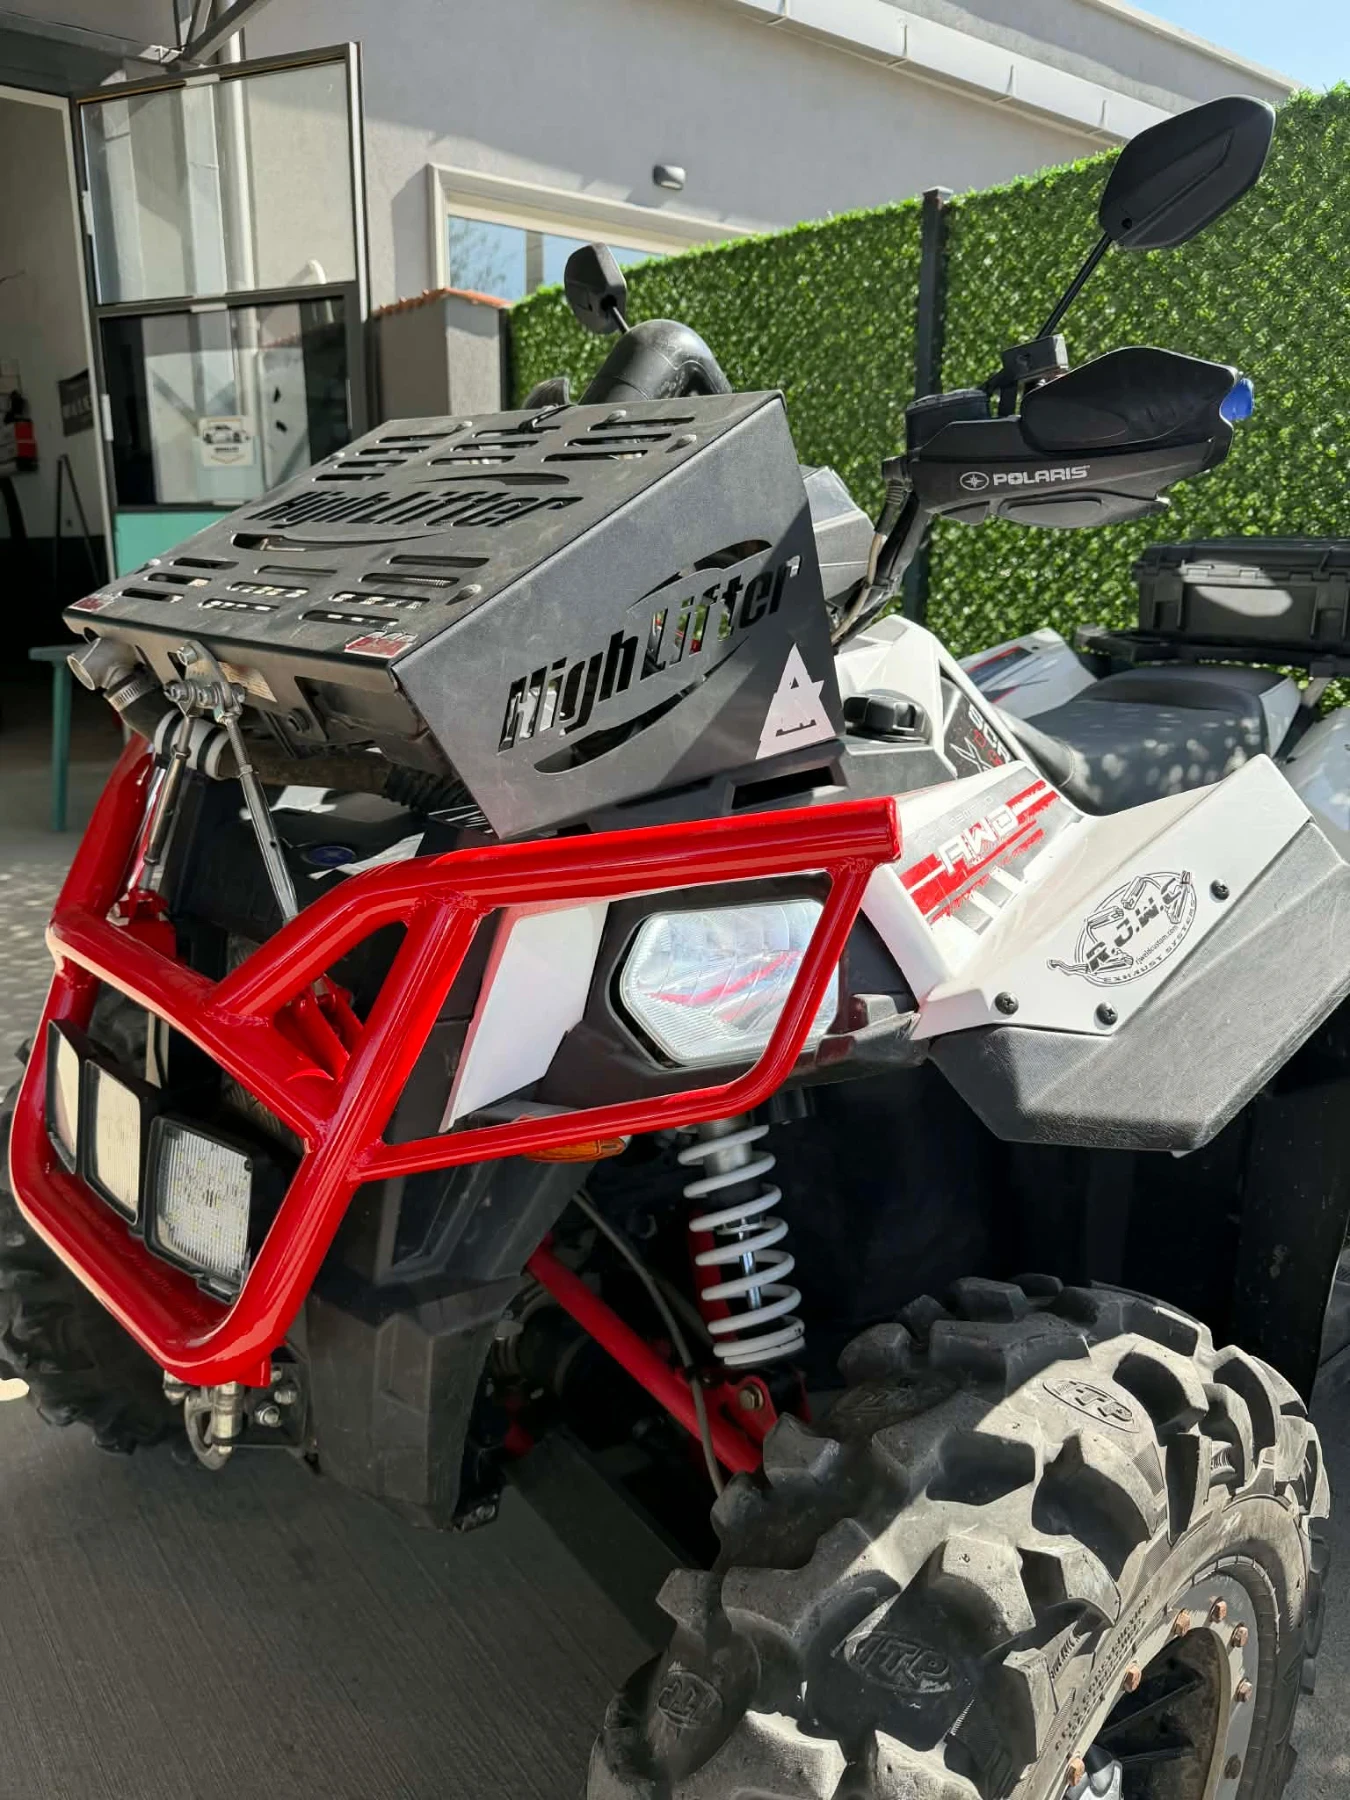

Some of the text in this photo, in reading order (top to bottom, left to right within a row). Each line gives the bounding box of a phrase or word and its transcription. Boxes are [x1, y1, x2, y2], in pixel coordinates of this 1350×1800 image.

[993, 466, 1089, 486] POLARIS
[938, 803, 1019, 874] AWD
[1103, 898, 1196, 983] EXHAUST SYSTEMS
[1054, 1380, 1132, 1421] ITP
[851, 1636, 951, 1684] ITP
